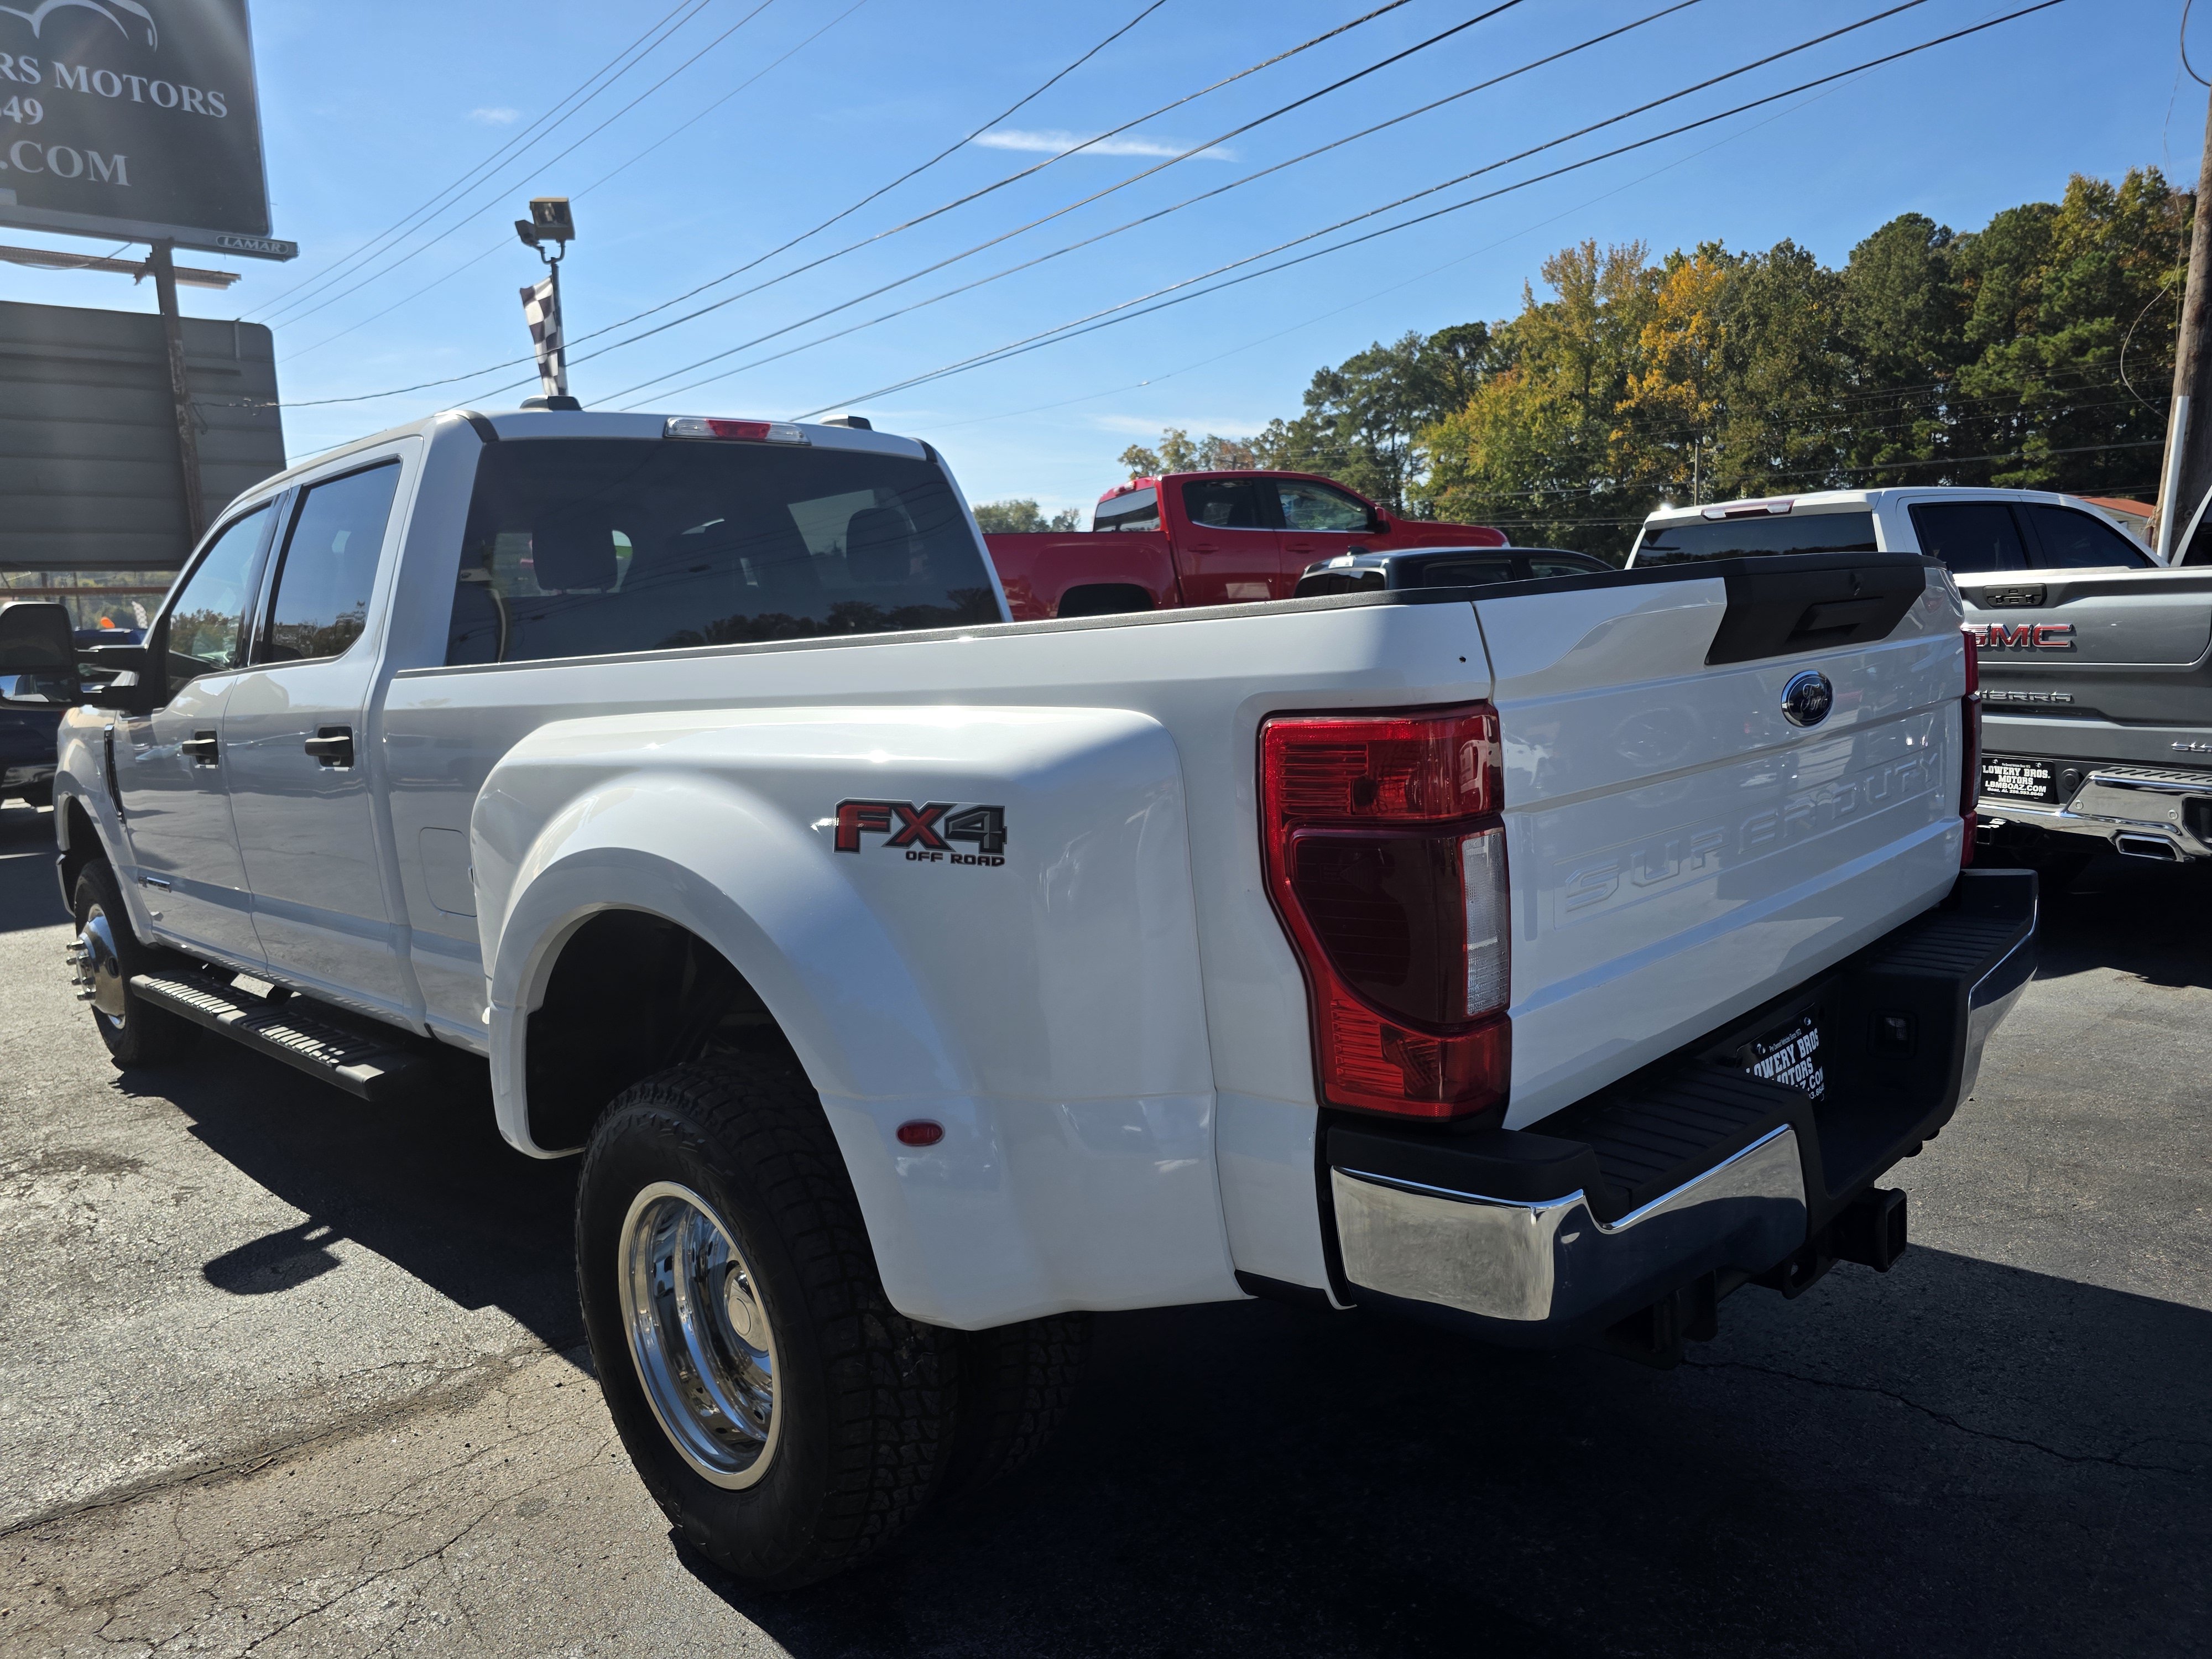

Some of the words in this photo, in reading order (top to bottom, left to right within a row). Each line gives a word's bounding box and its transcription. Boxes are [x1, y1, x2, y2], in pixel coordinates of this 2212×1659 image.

[51, 60, 228, 118] MOTORS
[0, 95, 44, 125] 49
[223, 237, 281, 253] LAMAR
[1974, 690, 2071, 702] IERRA
[1982, 765, 2021, 776] LOWERY
[2023, 768, 2051, 779] BROS.
[1998, 774, 2033, 785] MOTORS
[1985, 780, 2047, 793] LBMBOAZ.COM
[833, 797, 1008, 855] FX4
[1564, 798, 1817, 913] SUPER
[1831, 752, 1938, 821] DUTY
[905, 851, 943, 863] OFF
[950, 853, 1005, 867] ROAD
[1746, 1044, 1796, 1078] OWERY
